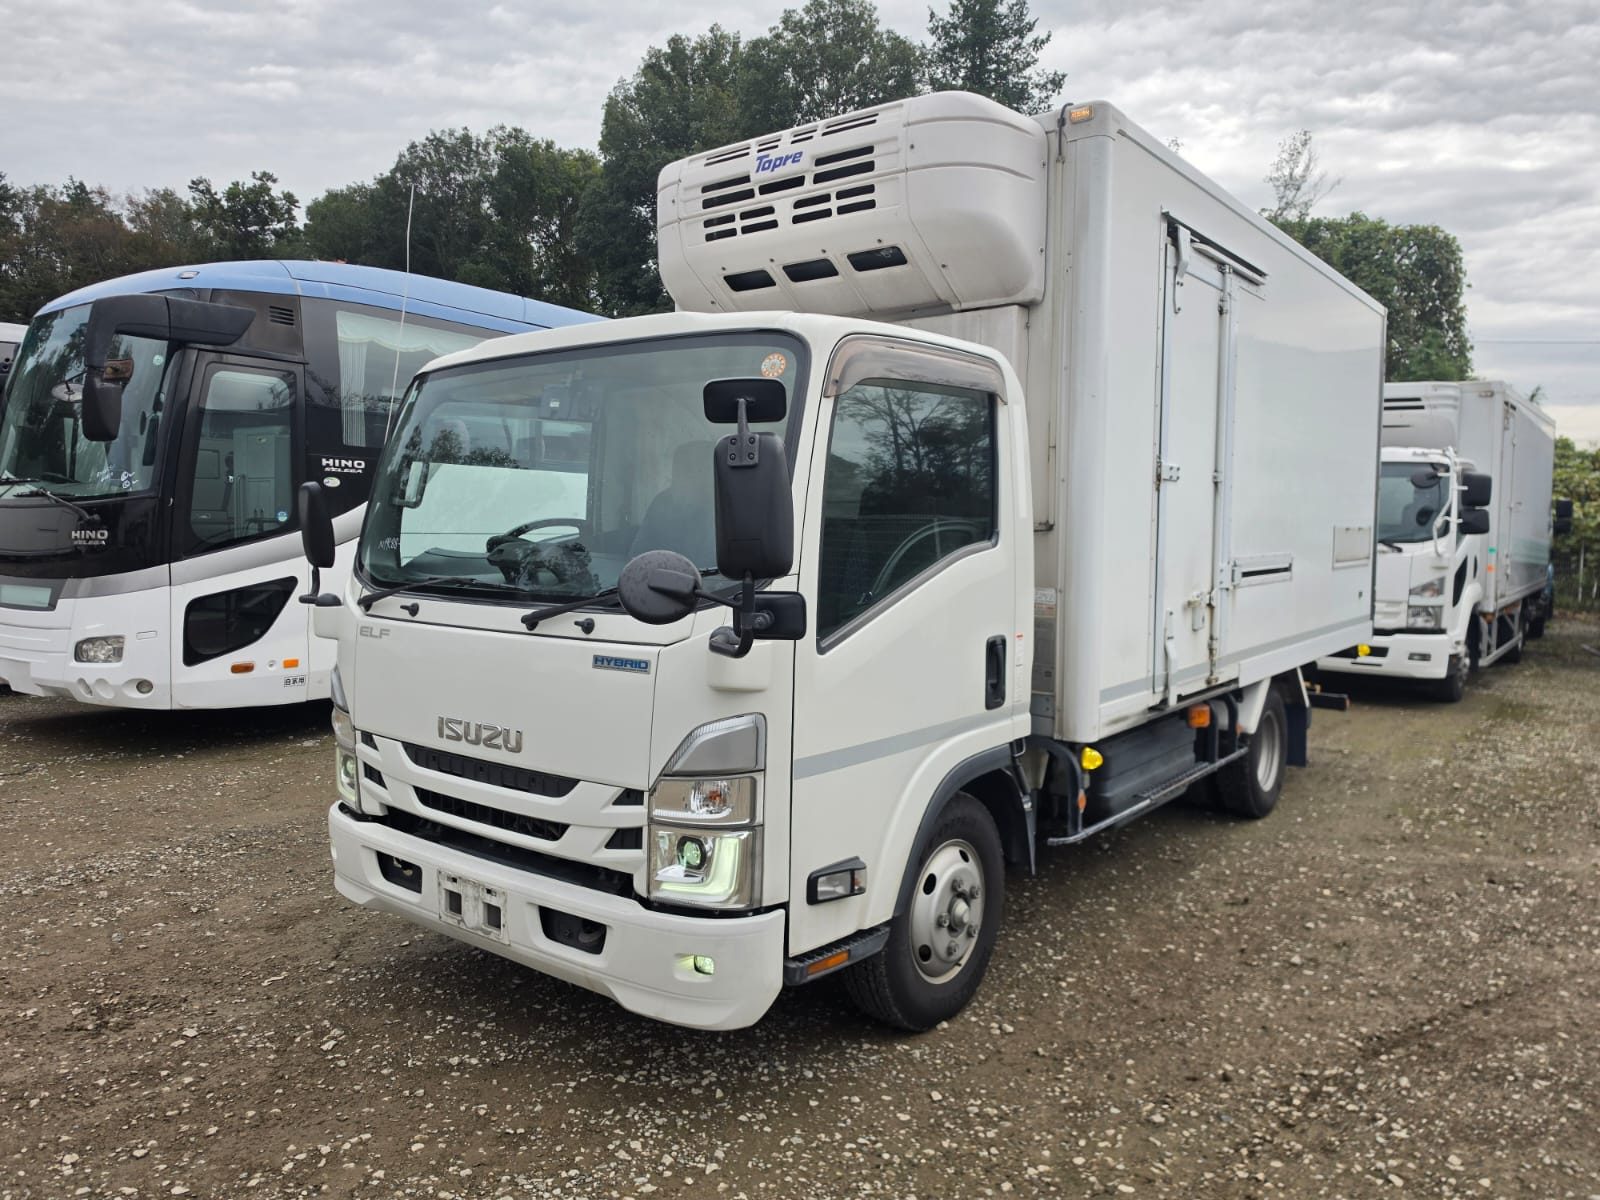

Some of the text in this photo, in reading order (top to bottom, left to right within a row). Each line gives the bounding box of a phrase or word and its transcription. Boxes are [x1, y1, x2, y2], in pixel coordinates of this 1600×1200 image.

[755, 151, 803, 173] Topre
[321, 458, 366, 469] HINO
[71, 530, 109, 540] HINO
[359, 625, 391, 639] ELF
[594, 655, 649, 670] HYBRID
[437, 715, 523, 754] ISUZU
